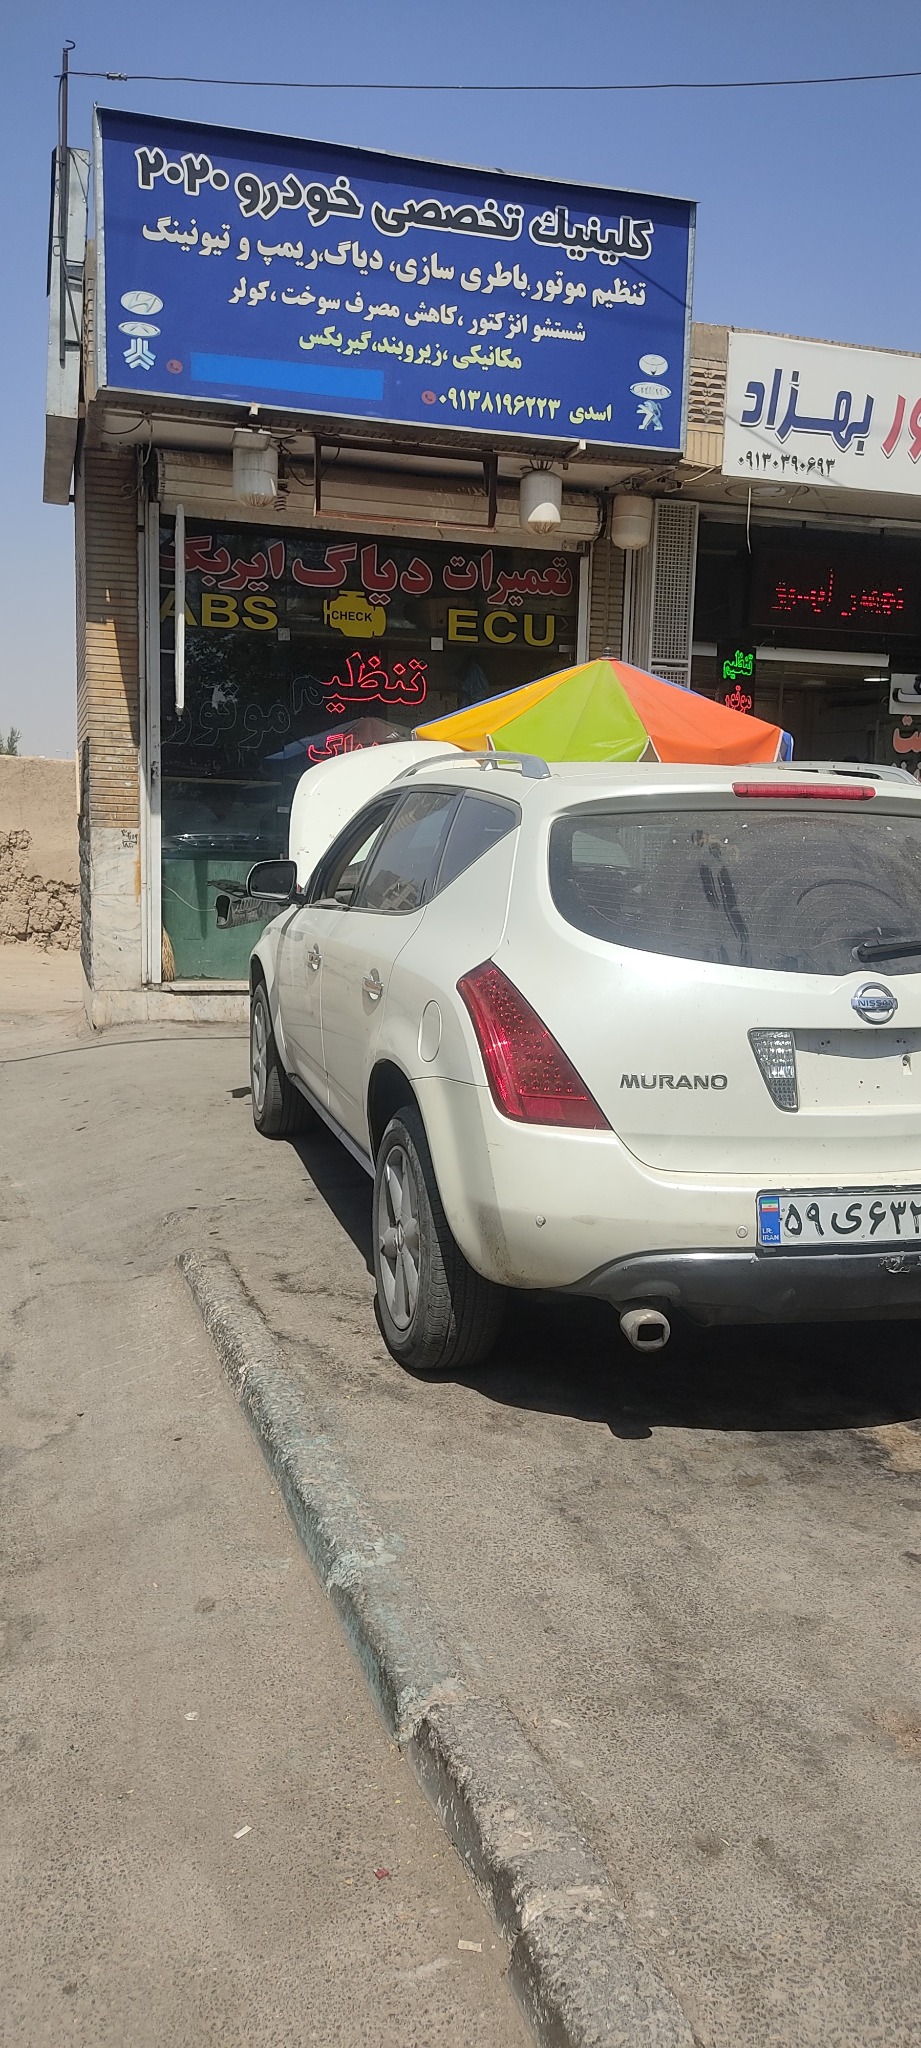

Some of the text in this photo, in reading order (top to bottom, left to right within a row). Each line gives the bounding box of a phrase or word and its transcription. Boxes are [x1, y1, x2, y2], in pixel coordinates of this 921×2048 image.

[135, 147, 229, 196] ۲۰۲۰
[234, 173, 364, 227] خودرو
[371, 199, 524, 241] تخصصی
[142, 216, 231, 256] تیونینگ
[236, 235, 250, 260] و
[281, 285, 341, 314] سوخت
[345, 291, 400, 321] مصرف
[592, 278, 647, 309] تنظیم
[467, 311, 528, 339] انژکتور
[531, 317, 587, 342] شستشو
[452, 344, 522, 370] مکانیکی
[438, 387, 612, 424] اسدی ۰۹۱۳۸۱۹۶۲۲۳
[740, 368, 875, 455] بهزاد
[737, 450, 836, 477] ۰۹۱۳۰۳۹۰۶۹۳
[291, 543, 433, 605] دیاگ
[442, 549, 573, 606] تعمیرات
[160, 590, 279, 631] ABS
[331, 610, 373, 623] CHECK
[447, 608, 556, 648] ECU
[723, 650, 753, 679] تنظیم
[857, 999, 894, 1007] NISSAN
[619, 1073, 728, 1090] MURANO
[762, 1234, 780, 1242] IRAN
